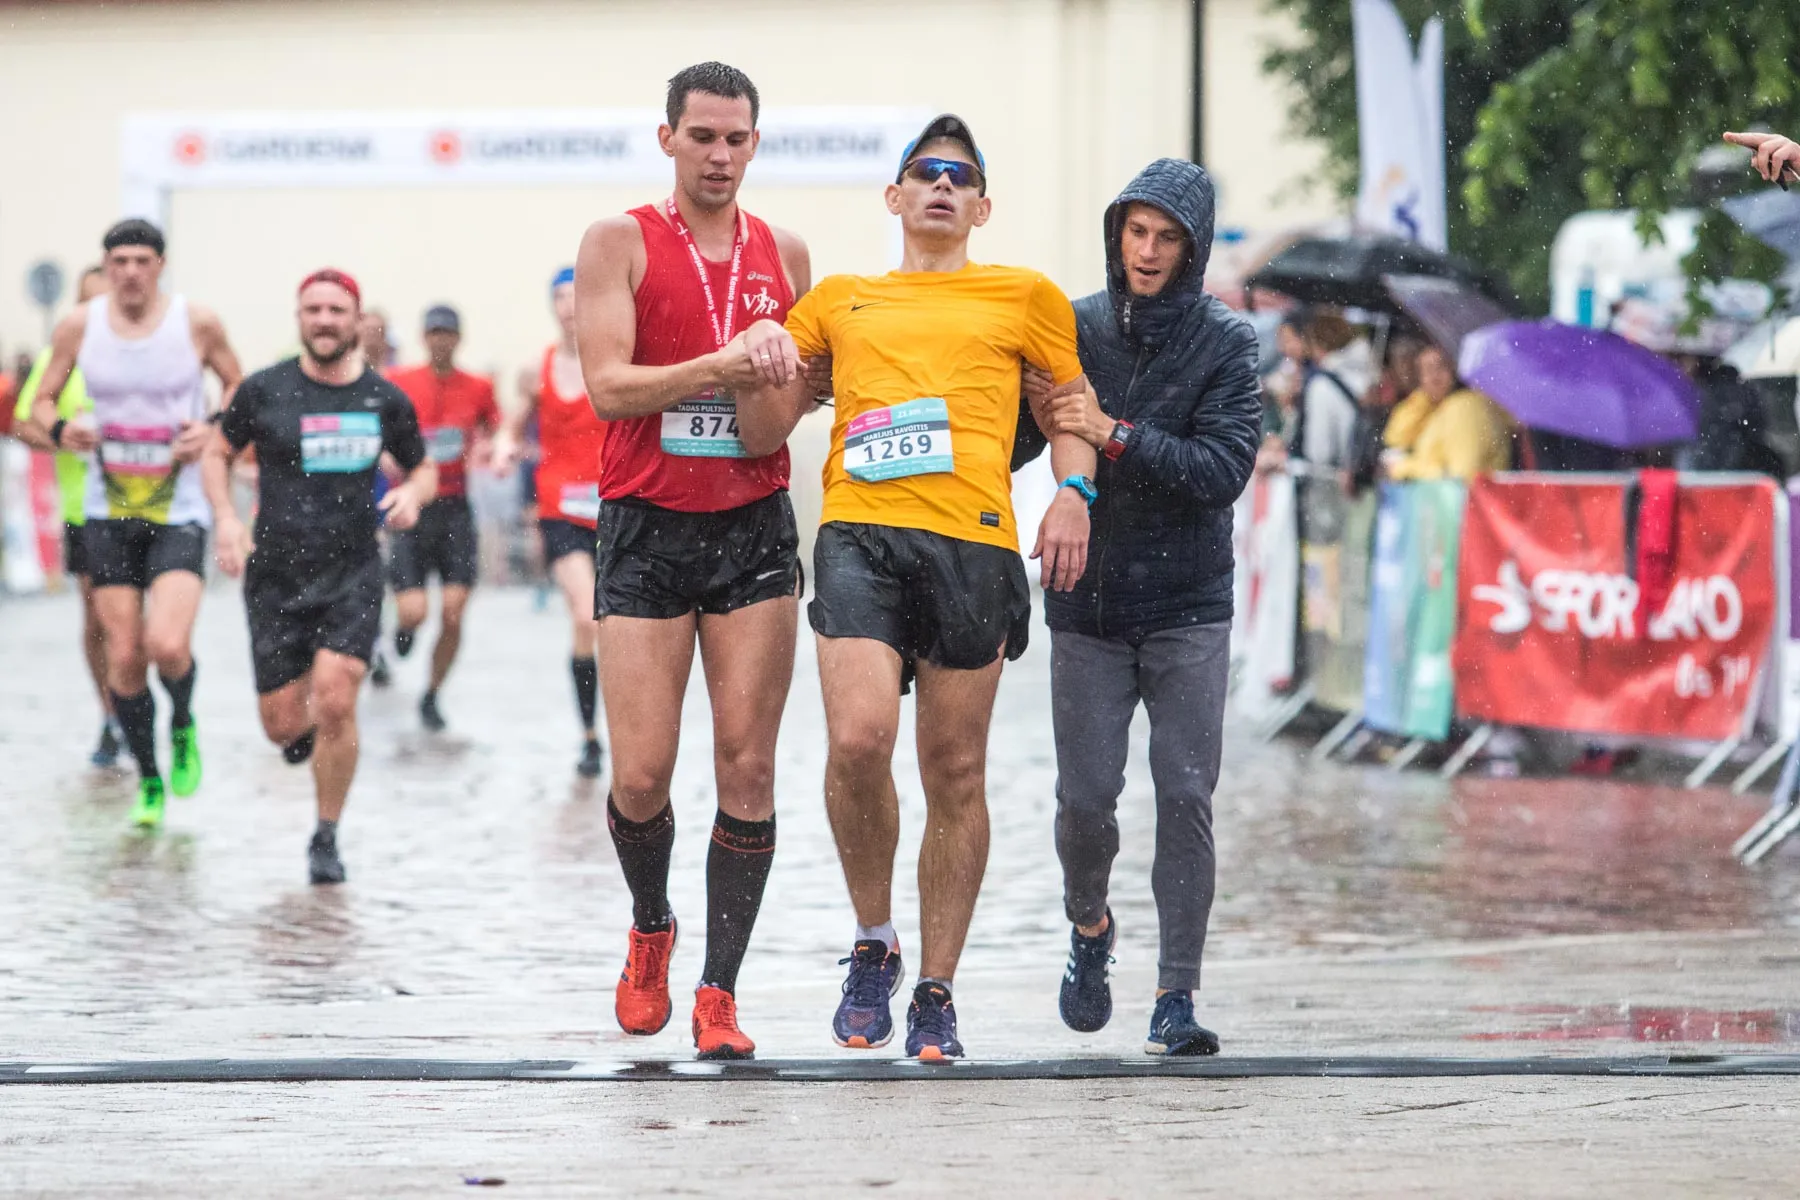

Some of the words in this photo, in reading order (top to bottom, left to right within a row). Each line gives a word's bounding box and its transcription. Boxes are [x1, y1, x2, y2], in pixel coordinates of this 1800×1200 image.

[678, 404, 700, 412] TADAS
[689, 415, 740, 438] 874
[863, 430, 894, 443] MARIJUS
[894, 423, 929, 435] RAVOITIS
[863, 434, 932, 463] 1269
